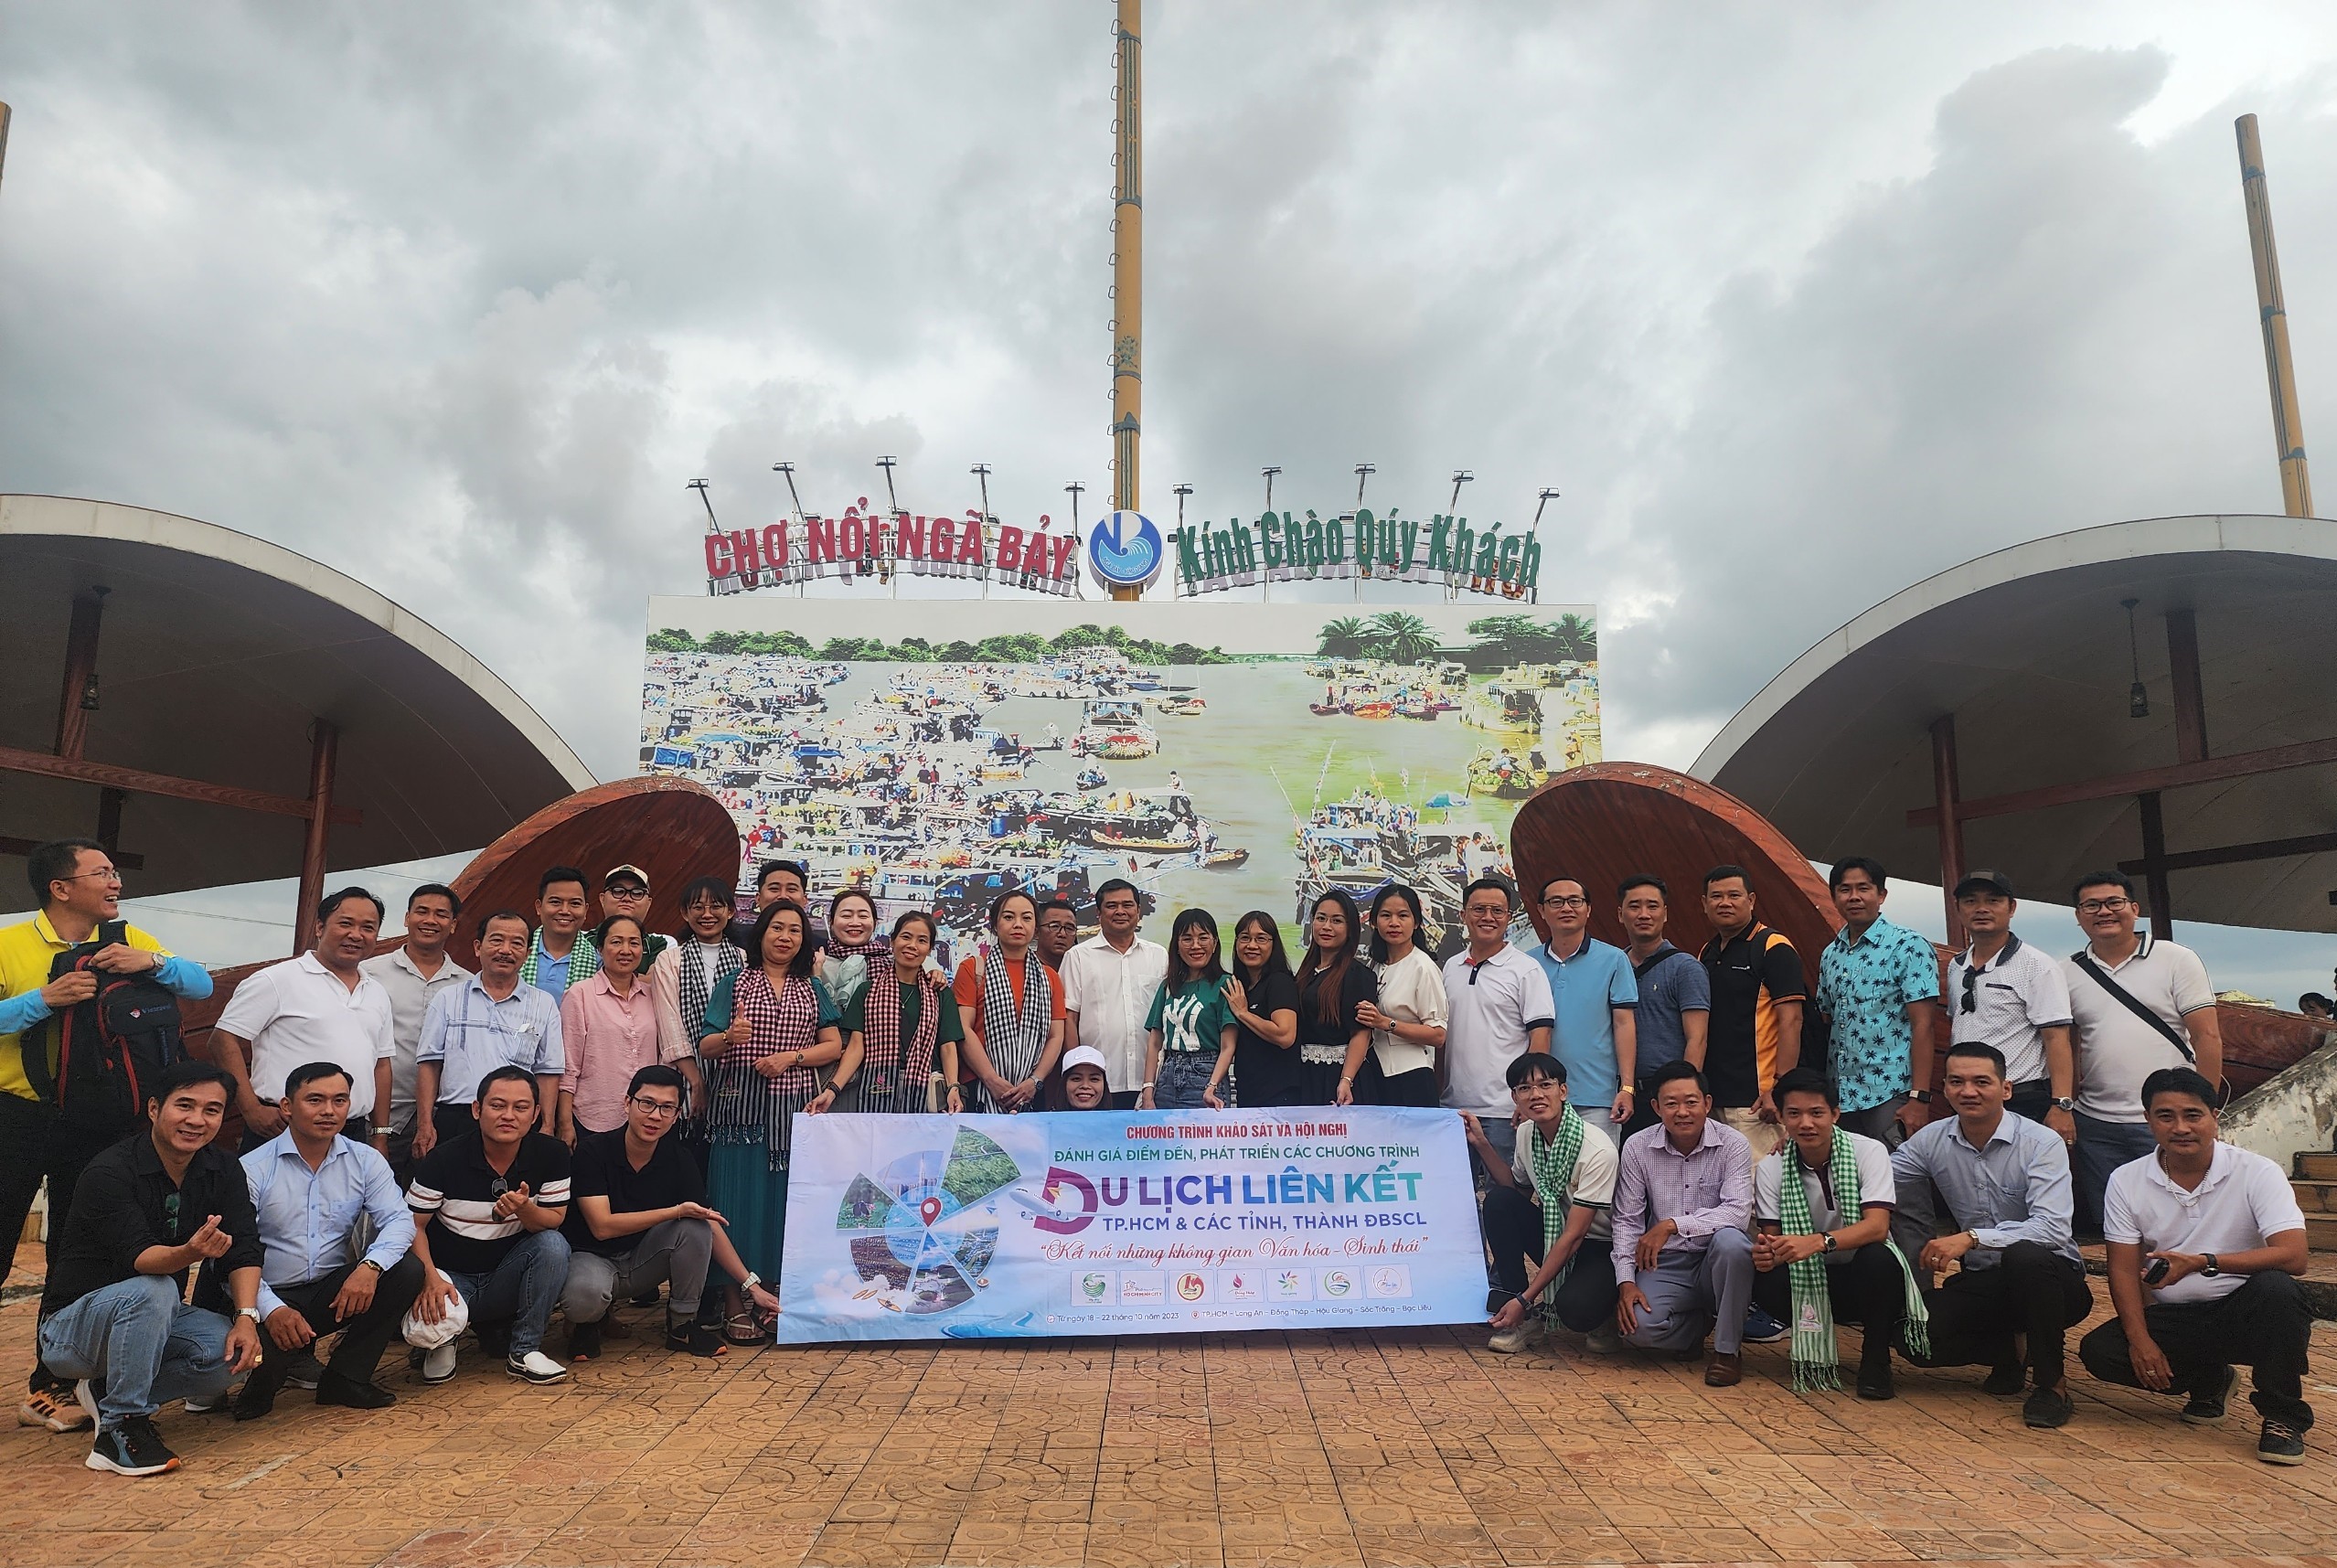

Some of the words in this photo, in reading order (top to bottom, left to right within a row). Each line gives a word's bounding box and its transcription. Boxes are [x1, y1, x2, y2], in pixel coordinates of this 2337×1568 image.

[705, 518, 789, 580] CHỢ
[807, 496, 880, 564] NỔI
[895, 509, 984, 565] NGÃ
[997, 514, 1077, 581] BẢY
[1176, 517, 1256, 583] Kính
[1261, 508, 1344, 569] Chào
[1427, 514, 1542, 588] Khách
[1126, 1124, 1175, 1139] CHƯƠNG
[1178, 1123, 1213, 1138] TRÌNH
[1216, 1121, 1248, 1138] KHẢO
[1251, 1122, 1274, 1137] SÁT
[1278, 1121, 1292, 1137] VÀ
[1295, 1121, 1315, 1139] HỘI
[1318, 1123, 1348, 1139] NGHỊ
[1054, 1147, 1094, 1162] ĐÁNH
[1098, 1147, 1123, 1162] GIÁ
[1126, 1144, 1160, 1161] ĐIỂM
[1164, 1145, 1197, 1162] ĐẾN,
[1200, 1145, 1236, 1160] PHÁT
[1239, 1143, 1280, 1159] TRIỂN
[1283, 1143, 1311, 1158] CÁC
[1315, 1144, 1375, 1158] CHƯƠNG
[1379, 1143, 1420, 1158] TRÌNH
[1033, 1166, 1128, 1234] DU
[1139, 1175, 1233, 1214] LỊCH
[1242, 1165, 1335, 1204] LIÊN
[1344, 1159, 1424, 1203] KẾT
[1103, 1217, 1170, 1232] TP.HCM
[1176, 1217, 1188, 1231] &
[1193, 1212, 1233, 1231] CÁC
[1237, 1210, 1287, 1232] TỈNH,
[1292, 1211, 1359, 1230] THÀNH
[1364, 1211, 1427, 1227] ĐBSCL
[1088, 1243, 1114, 1259] nối
[1116, 1243, 1166, 1268] những
[1168, 1242, 1215, 1268] không
[1215, 1245, 1254, 1267] gian
[1258, 1235, 1300, 1259] Văn
[1303, 1241, 1331, 1257] hóa
[1343, 1234, 1388, 1259] Sinh
